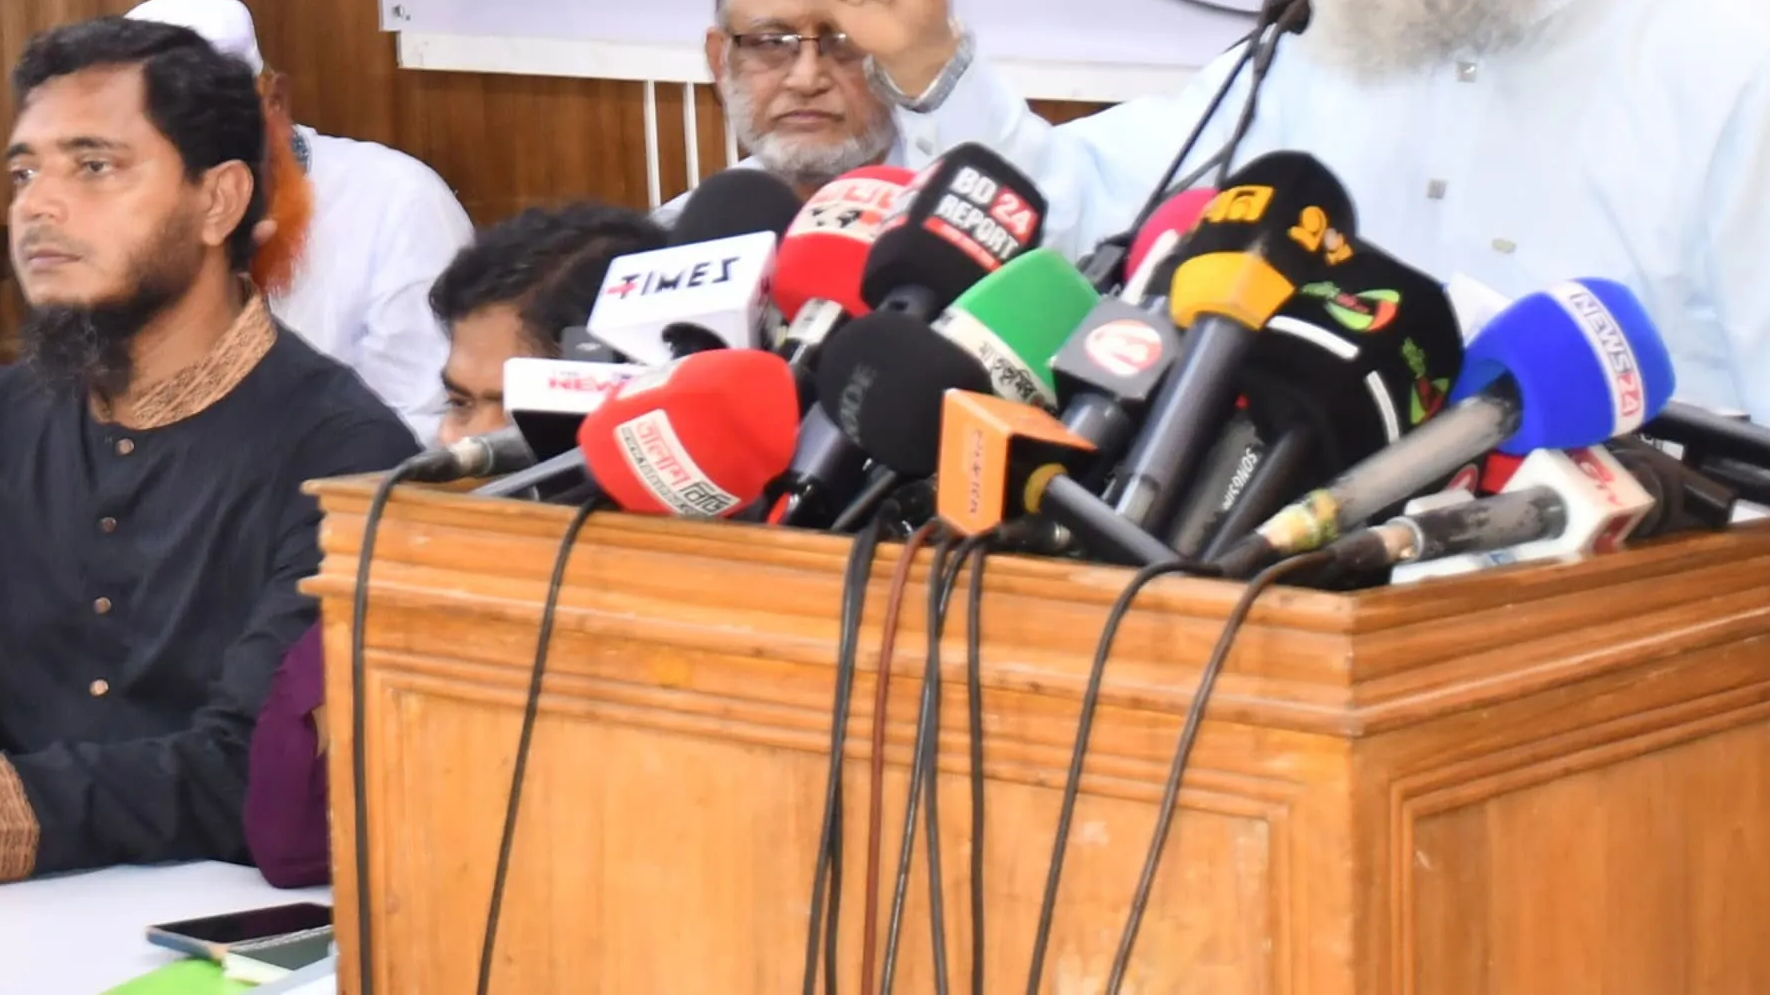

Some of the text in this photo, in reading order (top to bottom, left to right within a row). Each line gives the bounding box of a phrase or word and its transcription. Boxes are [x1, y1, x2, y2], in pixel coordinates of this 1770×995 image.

[933, 193, 1020, 260] REPORT
[949, 164, 998, 205] BD
[994, 190, 1034, 238] 24
